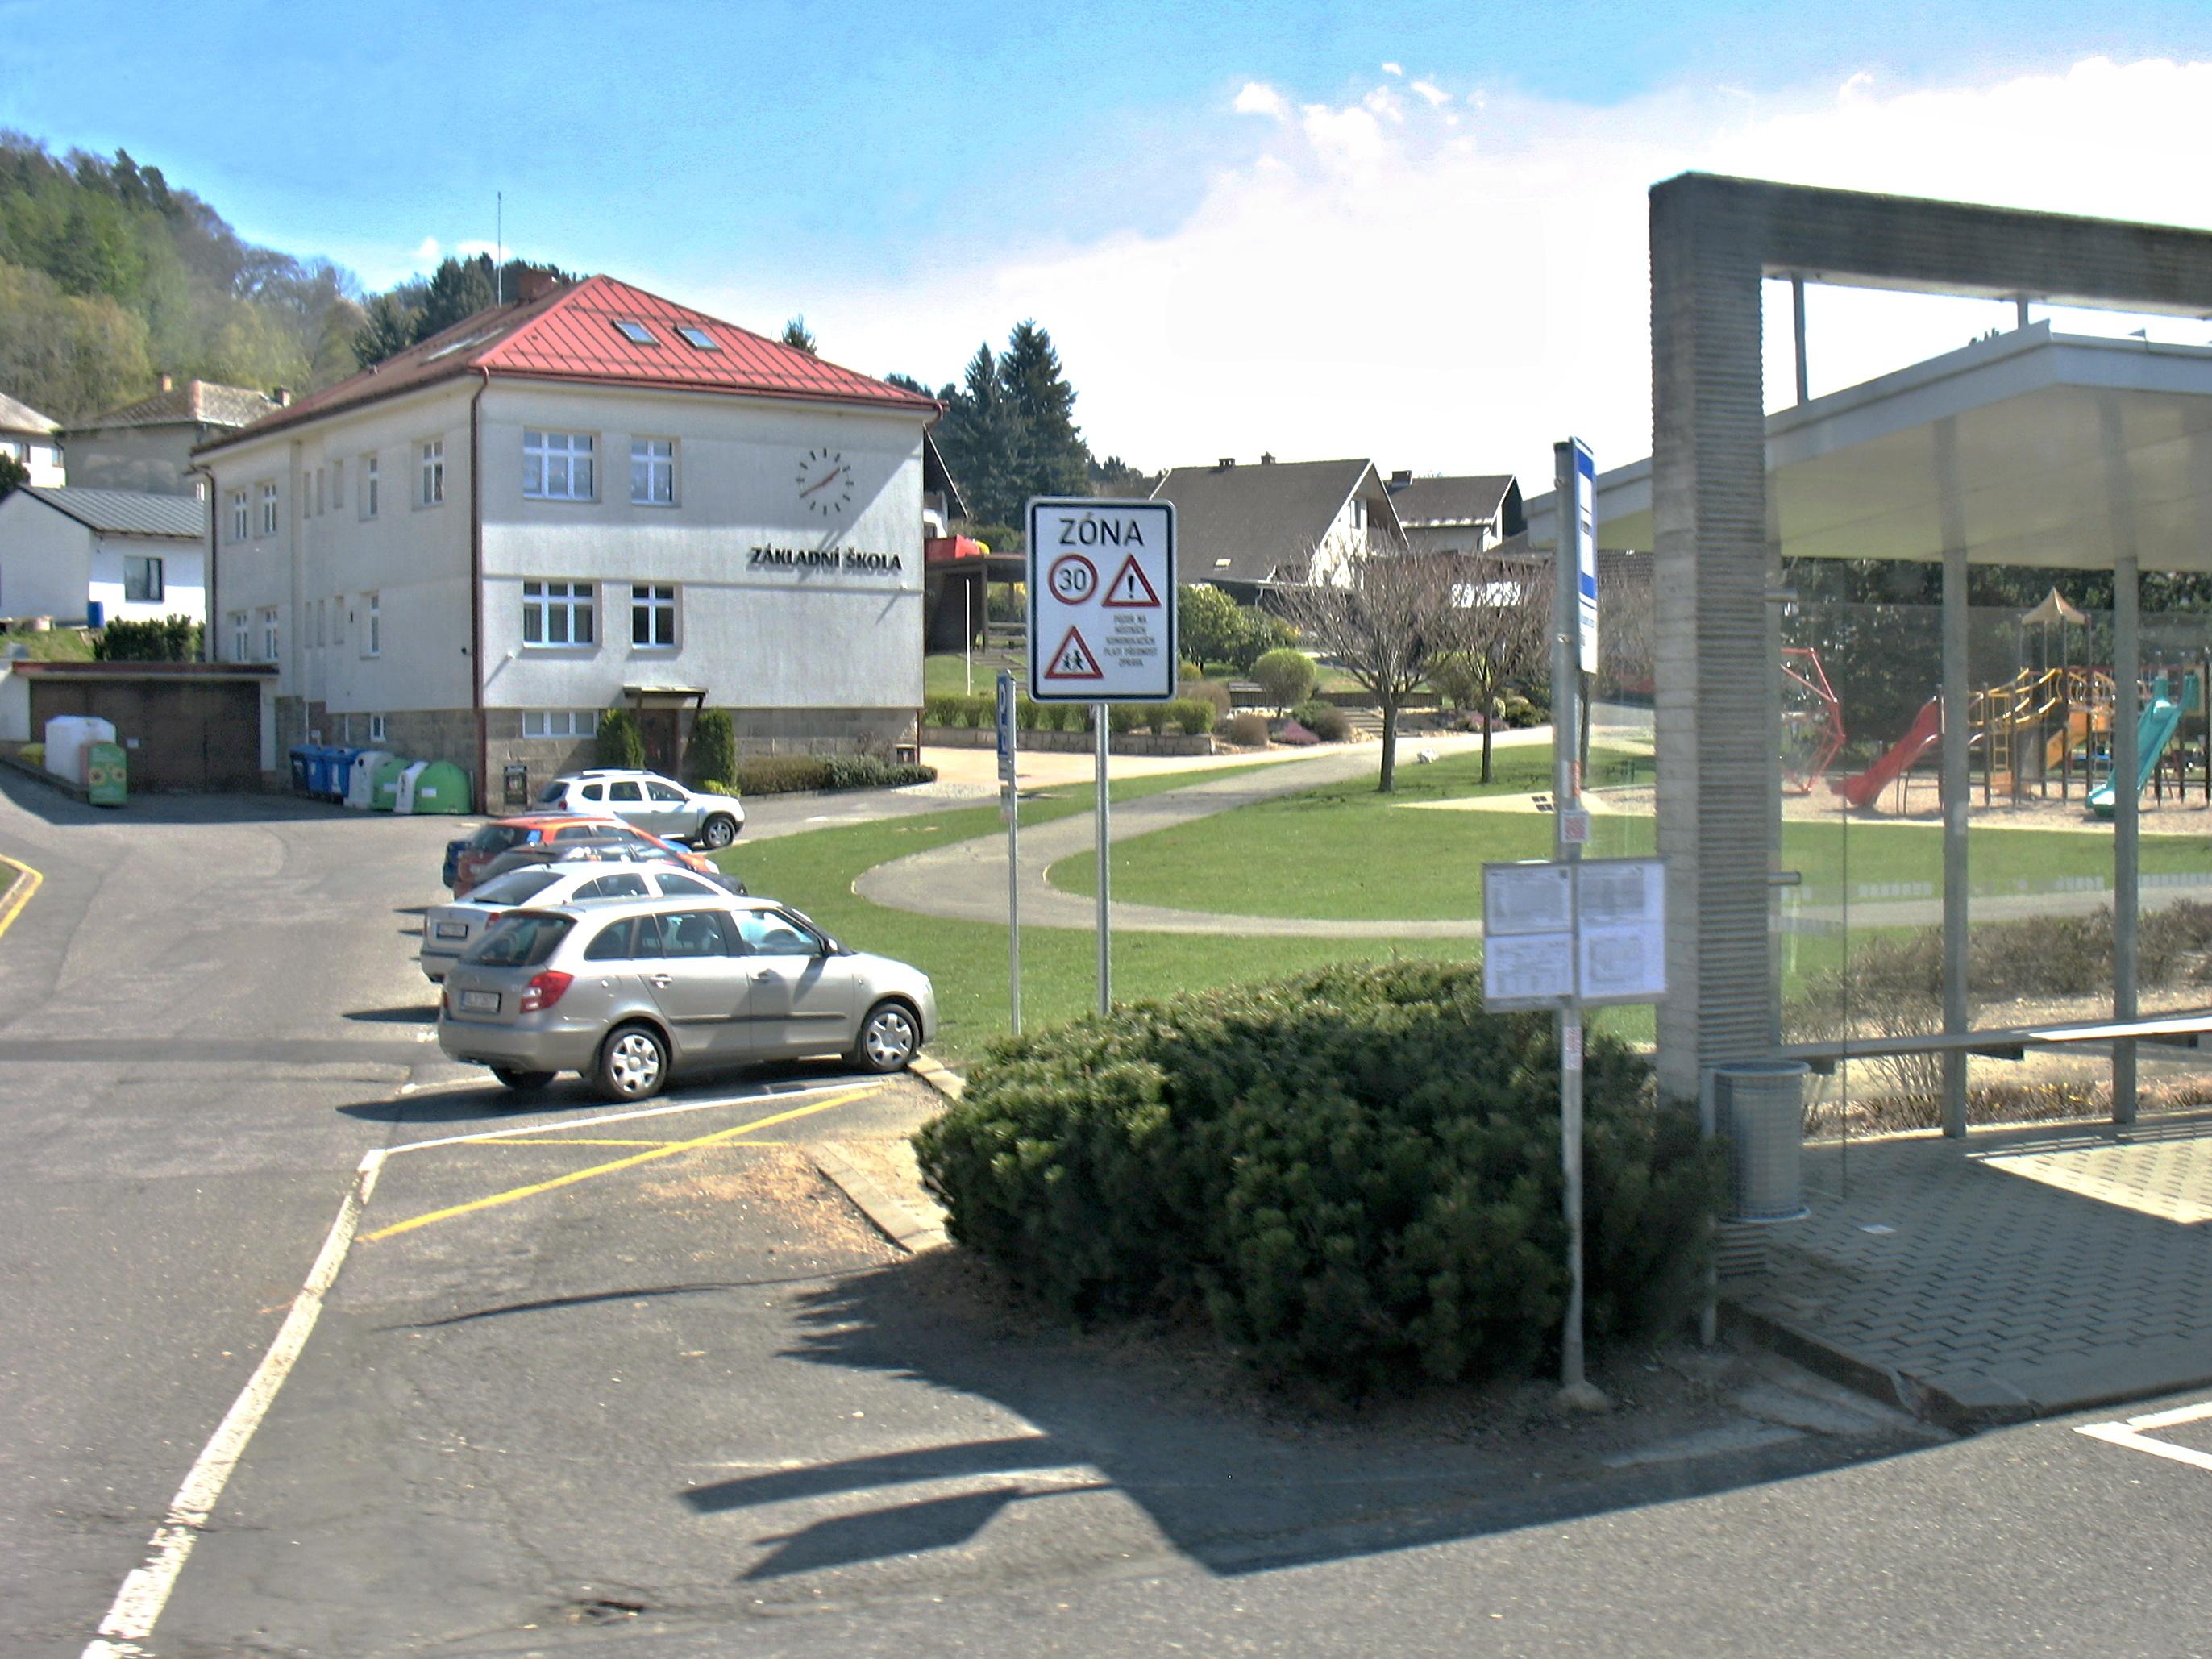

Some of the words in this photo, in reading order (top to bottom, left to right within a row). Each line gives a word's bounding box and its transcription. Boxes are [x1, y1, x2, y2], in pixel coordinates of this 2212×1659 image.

[1058, 512, 1145, 547] ZÓNA
[750, 543, 840, 568] ZÁKLADNÍ
[846, 547, 903, 571] ŠKOLA
[1058, 568, 1087, 591] 30
